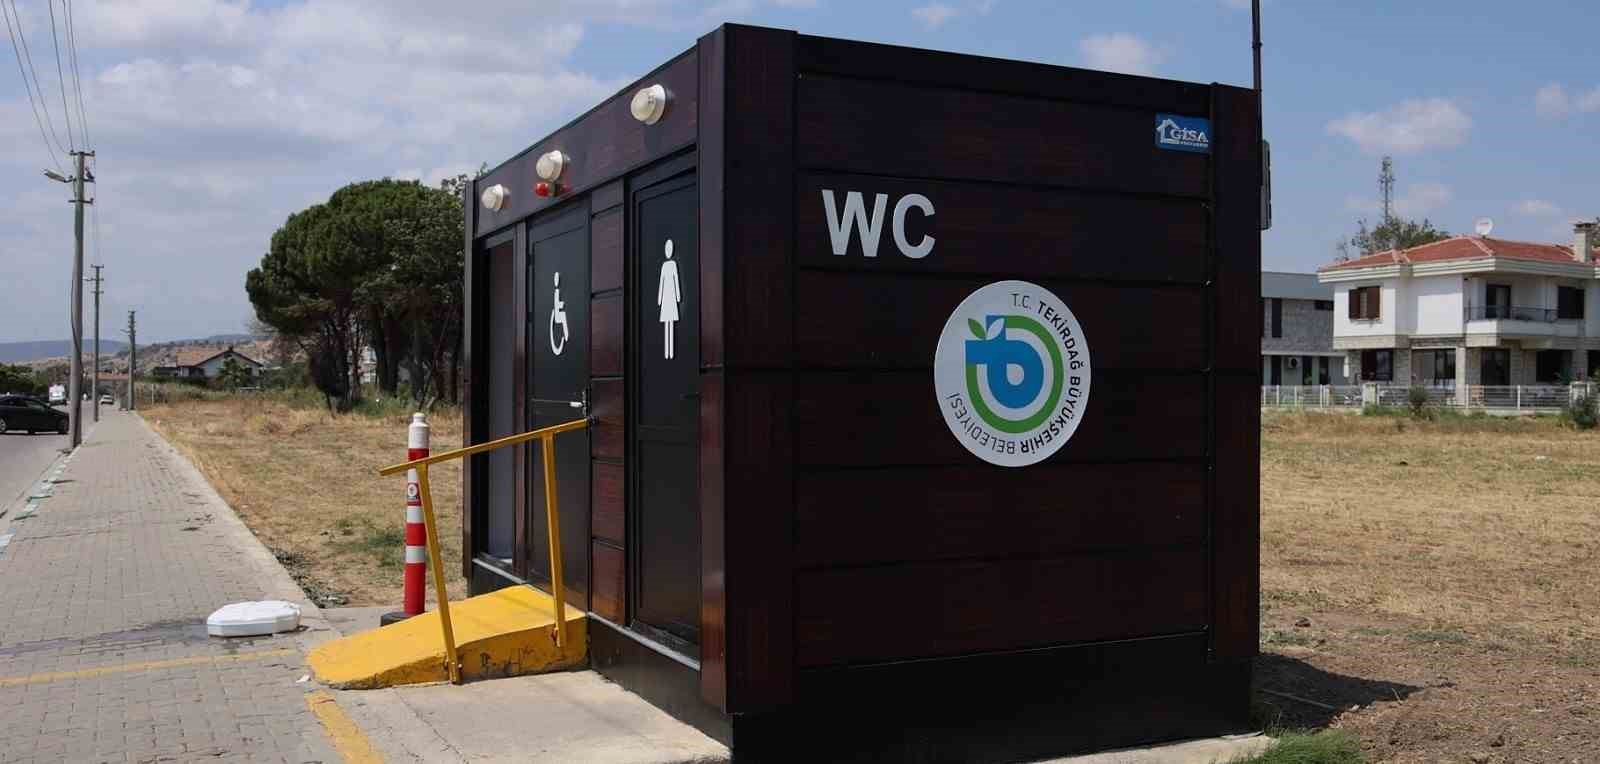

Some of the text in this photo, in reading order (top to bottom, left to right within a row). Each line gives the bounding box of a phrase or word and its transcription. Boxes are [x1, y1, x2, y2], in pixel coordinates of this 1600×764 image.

[821, 189, 936, 259] WC
[945, 293, 1086, 455] T.C. TEKİRDAĞ BÜYÜKŞEHİR BELEDİYESİ
